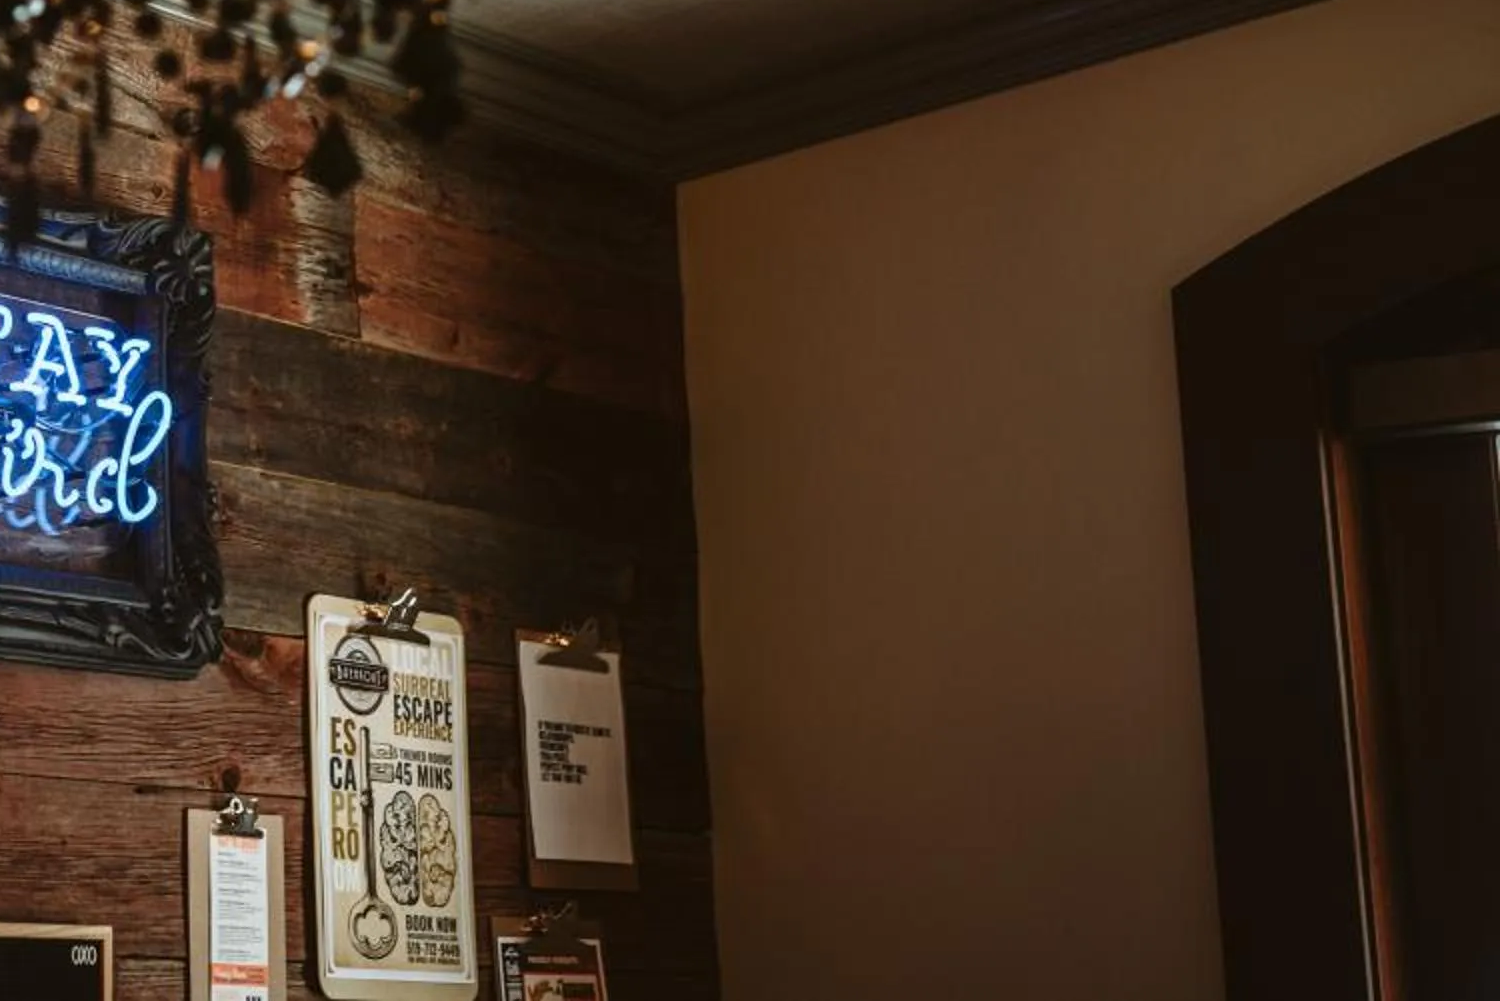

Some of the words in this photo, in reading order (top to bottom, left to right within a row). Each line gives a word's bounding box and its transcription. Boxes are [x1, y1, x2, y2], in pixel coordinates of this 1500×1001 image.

[393, 672, 451, 700] SURREAL
[393, 694, 453, 727] ESCAPE
[393, 718, 453, 743] EXPERIENCE
[395, 760, 413, 787] 45
[416, 764, 453, 792] MINS
[405, 914, 435, 933] BOOK
[435, 916, 457, 935] NOW
